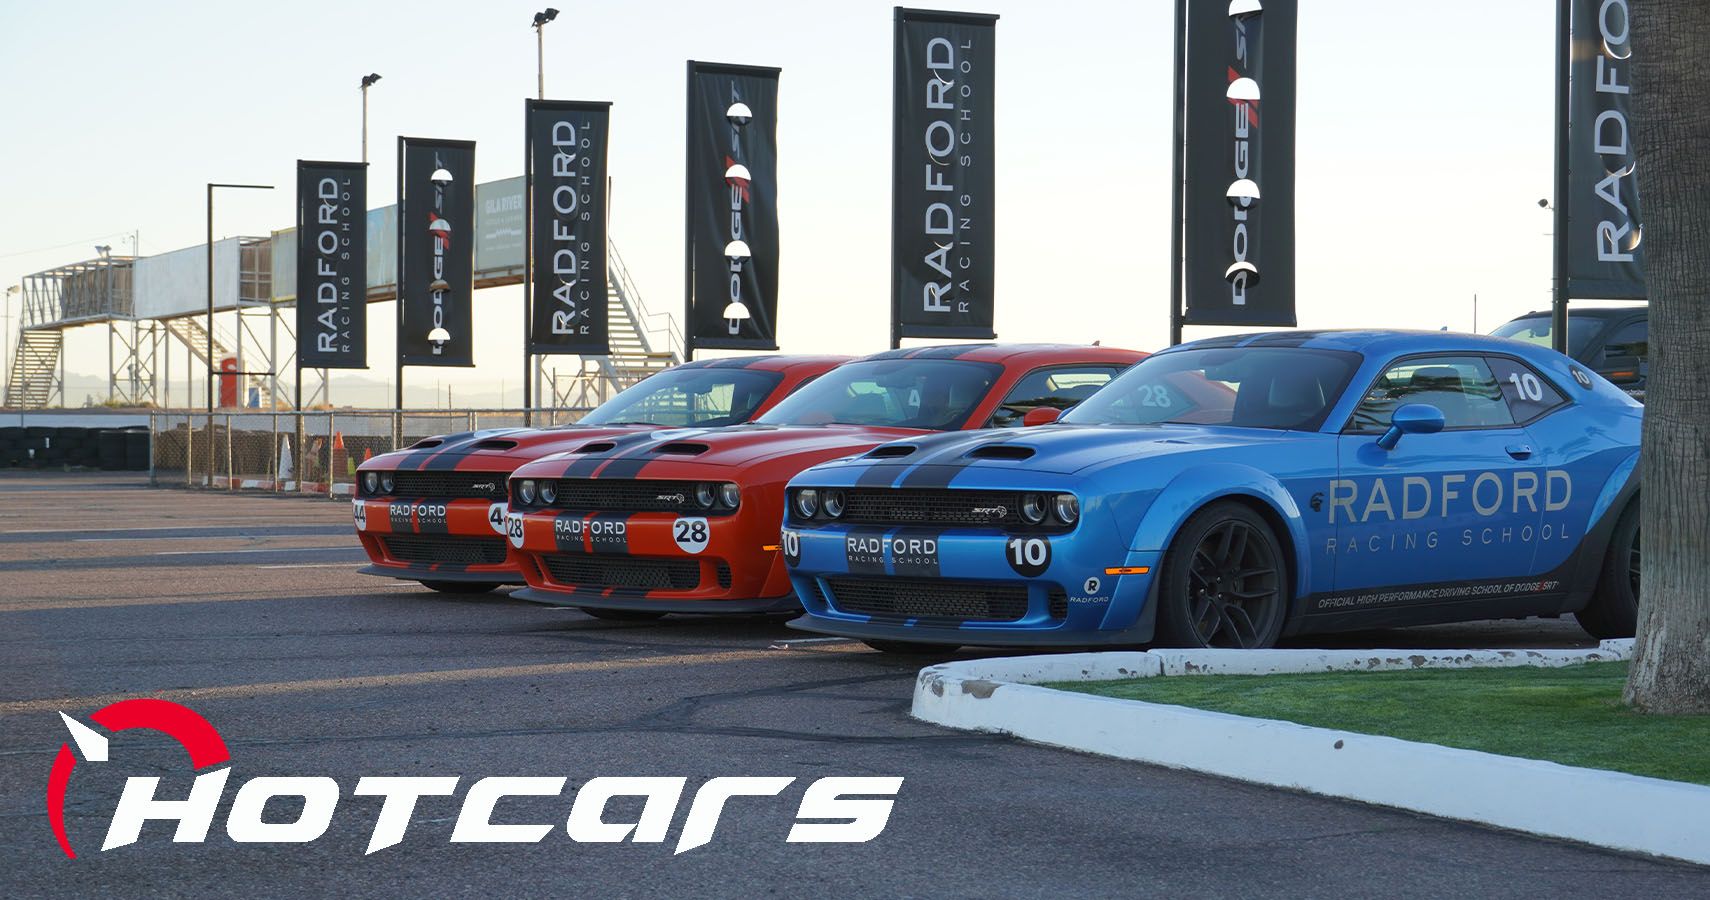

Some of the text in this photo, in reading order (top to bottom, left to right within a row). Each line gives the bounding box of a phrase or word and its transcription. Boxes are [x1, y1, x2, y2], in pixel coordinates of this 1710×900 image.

[925, 36, 956, 313] RADFORD
[957, 38, 973, 314] RACING SCHOOL
[552, 120, 577, 335] RADFORD
[579, 121, 591, 335] RACING SCHOOL
[317, 177, 339, 353] RADFORD
[341, 178, 351, 353] RACING SCHOOL
[1510, 372, 1544, 402] 10
[1571, 368, 1591, 386] 10
[1137, 384, 1171, 408] 28
[656, 494, 677, 502] SRT
[1328, 470, 1572, 524] RADFORD
[390, 504, 446, 517] RADFORD
[972, 507, 997, 515] SRT
[507, 517, 523, 538] 28
[555, 519, 626, 535] RADFORD
[556, 534, 627, 544] RACING SCHOOL
[675, 520, 707, 543] 28
[1326, 523, 1570, 555] RACING SCHOOL
[782, 531, 799, 557] 10
[847, 537, 936, 555] RADFORD
[1009, 537, 1047, 567] 10
[848, 555, 938, 566] RACING SCHOOL
[1318, 596, 1355, 609] OFFICIAL
[1356, 594, 1379, 604] HIGH
[1379, 589, 1438, 604] PERFORMANCE
[1438, 586, 1471, 598] DRIVING
[1471, 584, 1502, 595] SCHOOL
[1503, 583, 1515, 593] OF
